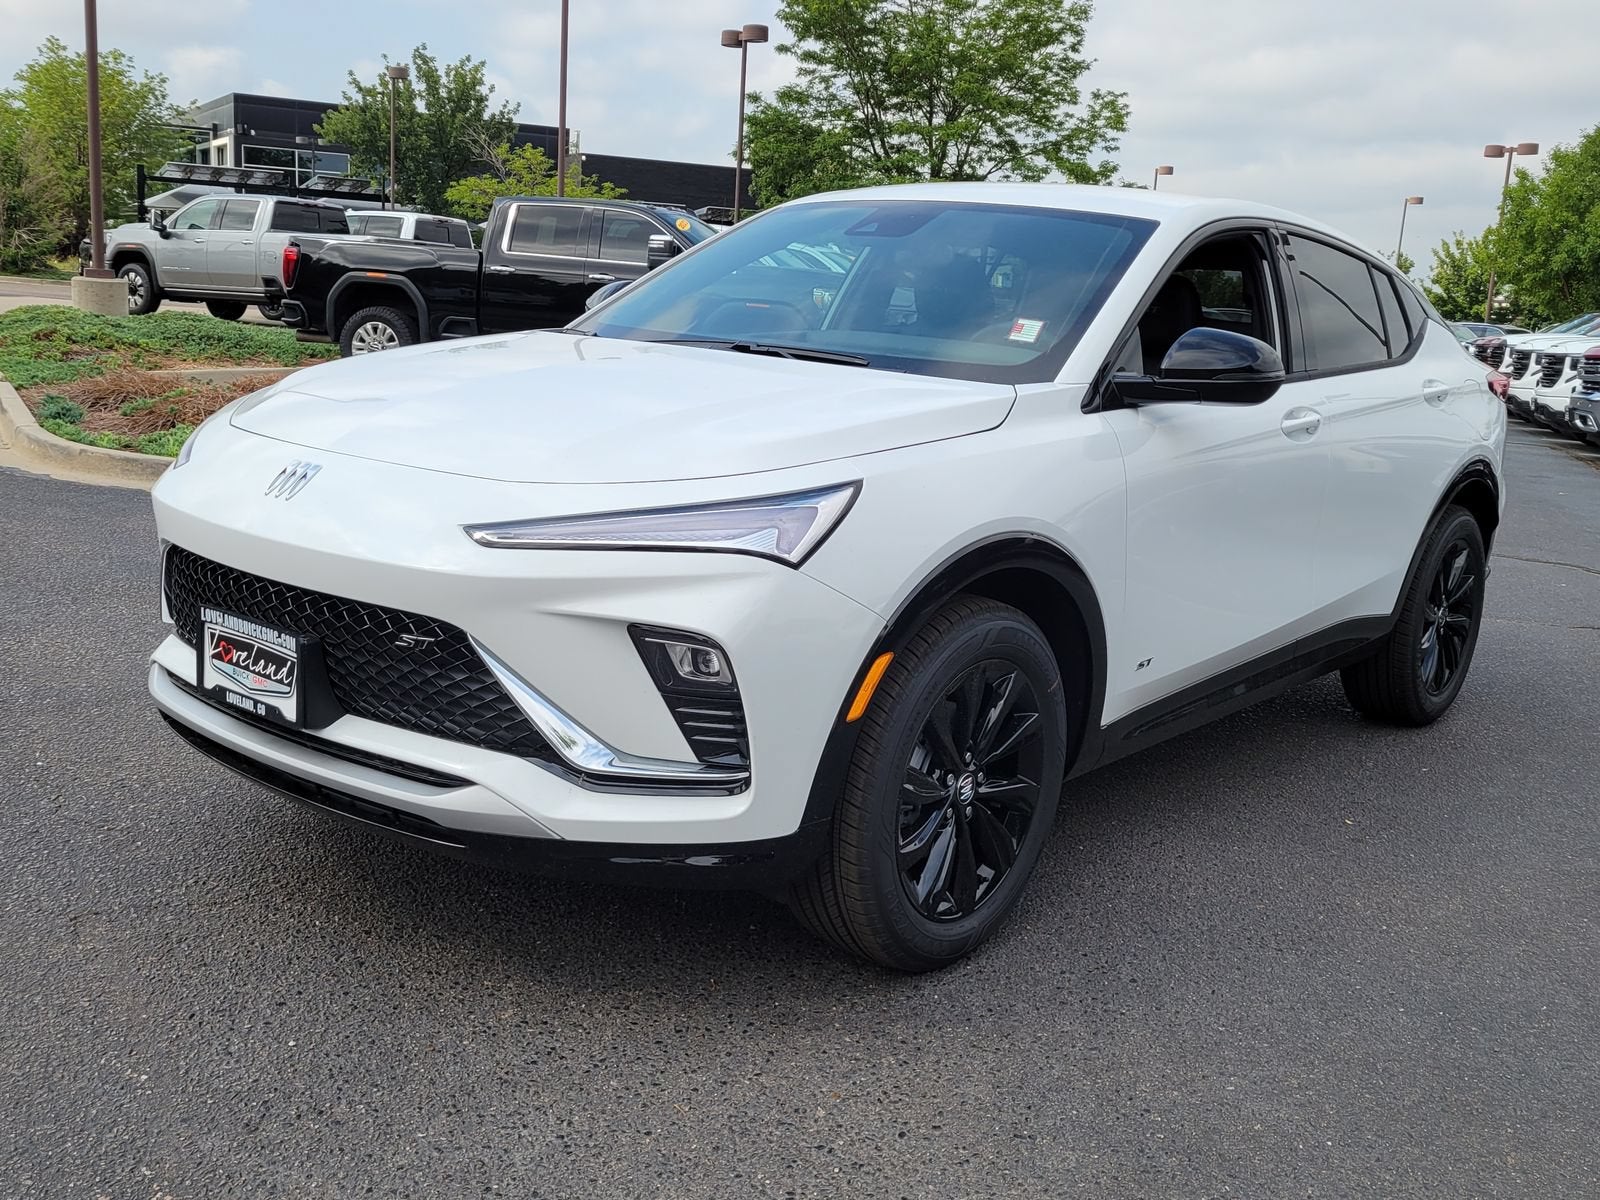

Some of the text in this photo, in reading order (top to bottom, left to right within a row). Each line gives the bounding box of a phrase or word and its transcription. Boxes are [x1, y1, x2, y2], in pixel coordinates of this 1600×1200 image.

[395, 634, 435, 650] ST
[1135, 656, 1154, 672] ST
[232, 667, 269, 688] BUICK GMC
[257, 703, 266, 716] CO
